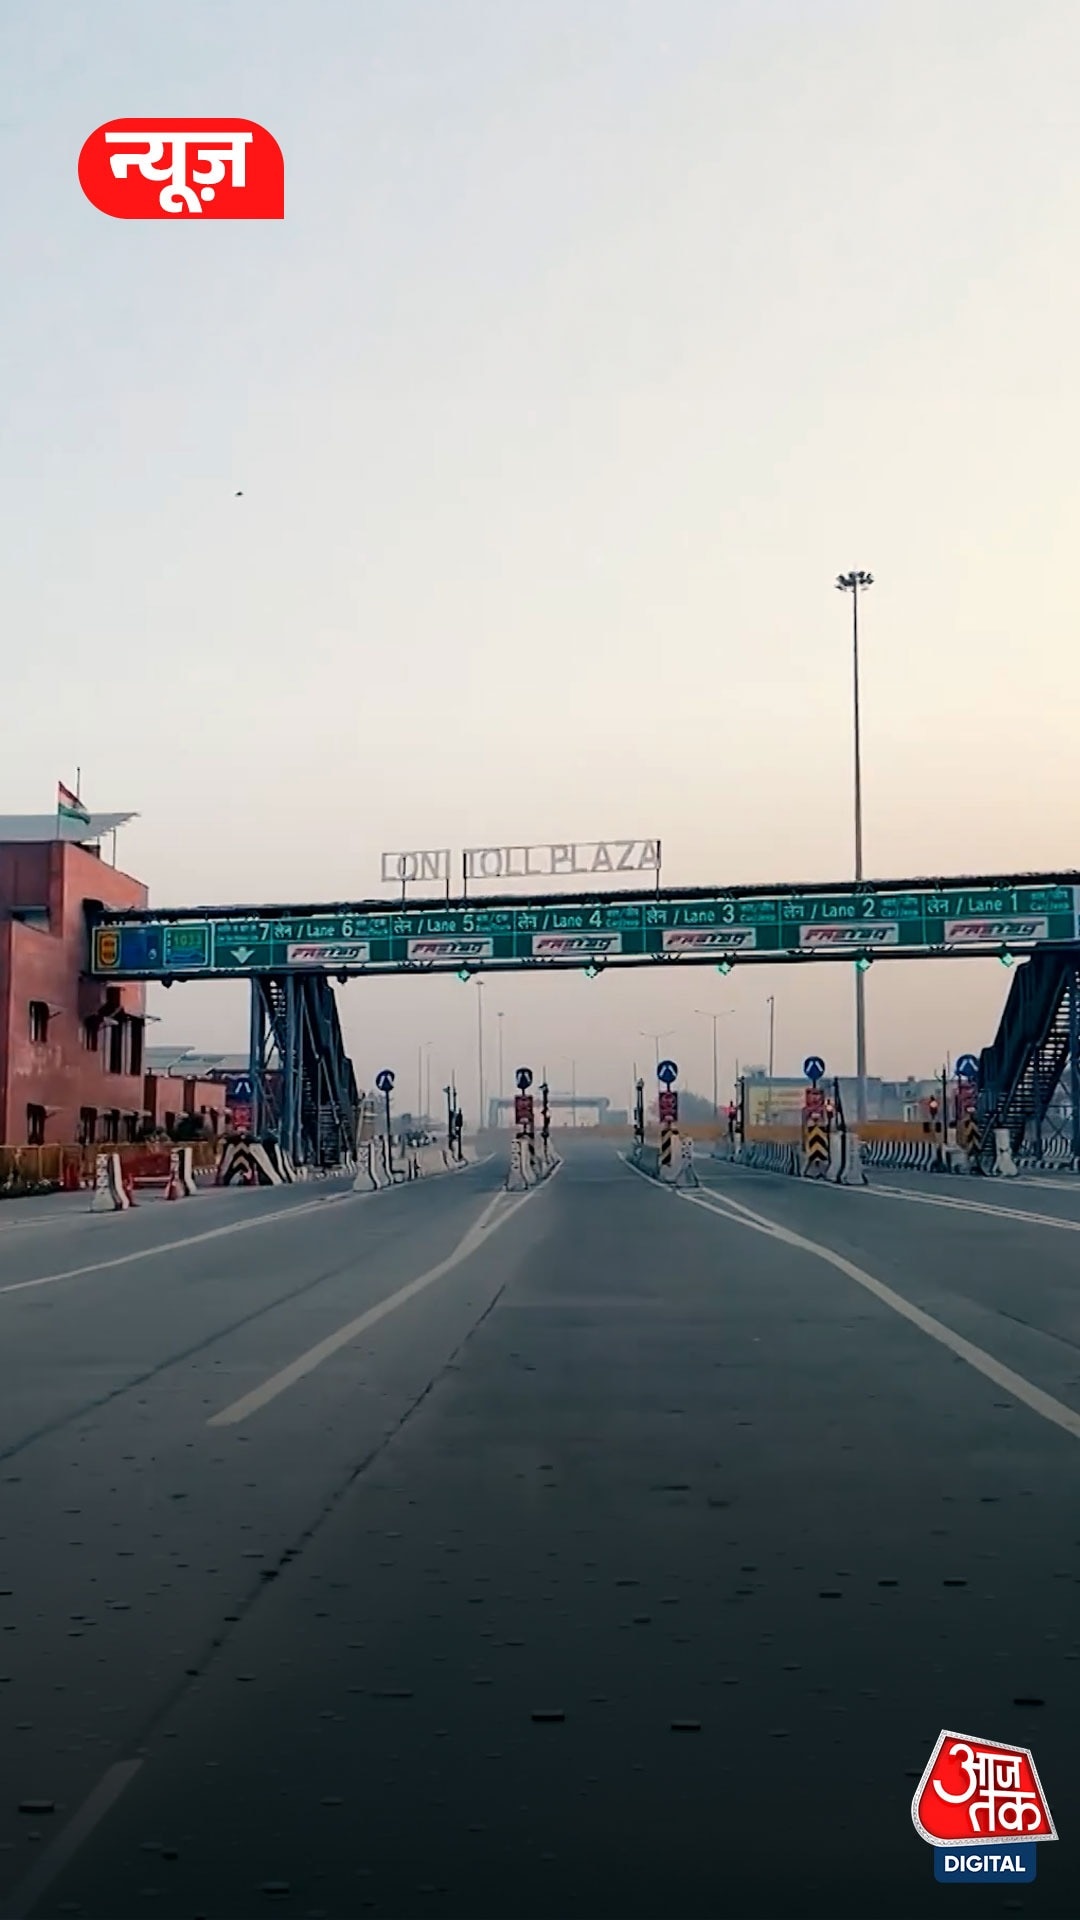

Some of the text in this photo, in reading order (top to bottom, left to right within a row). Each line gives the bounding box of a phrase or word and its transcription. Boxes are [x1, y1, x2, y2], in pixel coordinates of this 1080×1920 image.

[463, 847, 541, 878] TOLL
[550, 840, 661, 874] PLAZA
[784, 902, 804, 919] लेन
[821, 904, 855, 918] Lane
[863, 898, 876, 918] 2
[927, 896, 948, 913] लेन
[969, 898, 1002, 912] Lane
[1010, 892, 1018, 912] 1
[394, 916, 412, 934] लेन
[427, 918, 456, 932] Lane
[463, 914, 474, 932] 5
[518, 913, 537, 930] लेन
[553, 914, 582, 928] Lane
[589, 910, 603, 928] 4
[685, 909, 716, 923] Lane
[722, 904, 735, 924] 3
[258, 922, 270, 940] 7
[342, 919, 353, 937] 6
